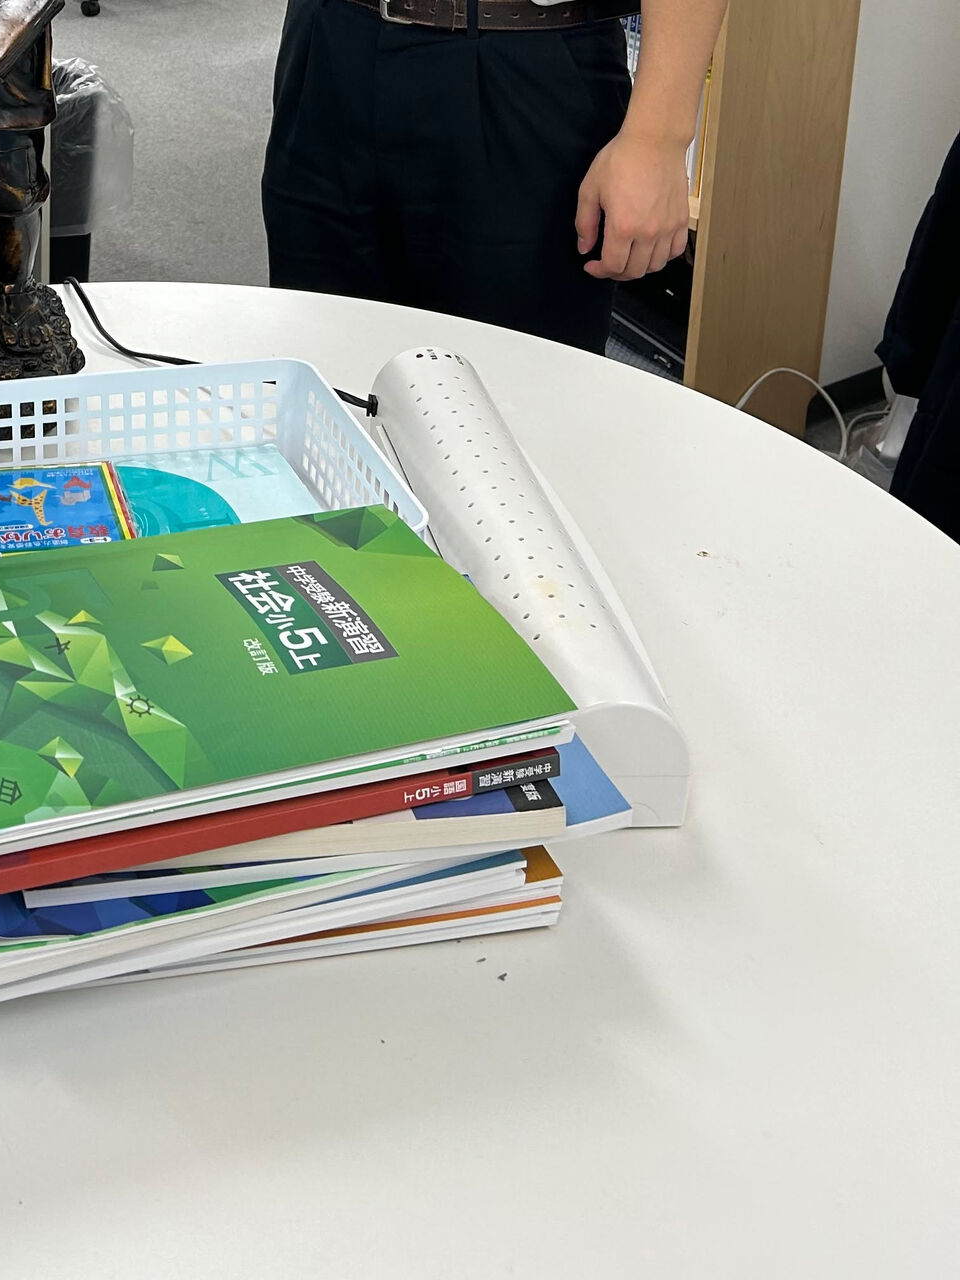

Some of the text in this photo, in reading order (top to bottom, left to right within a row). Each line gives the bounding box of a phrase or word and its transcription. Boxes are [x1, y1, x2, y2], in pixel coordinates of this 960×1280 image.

[228, 570, 328, 670] 社会小5上
[286, 565, 385, 655] 中学受験新演習
[243, 638, 278, 676] 改訂版
[404, 779, 467, 804] 国語小5上
